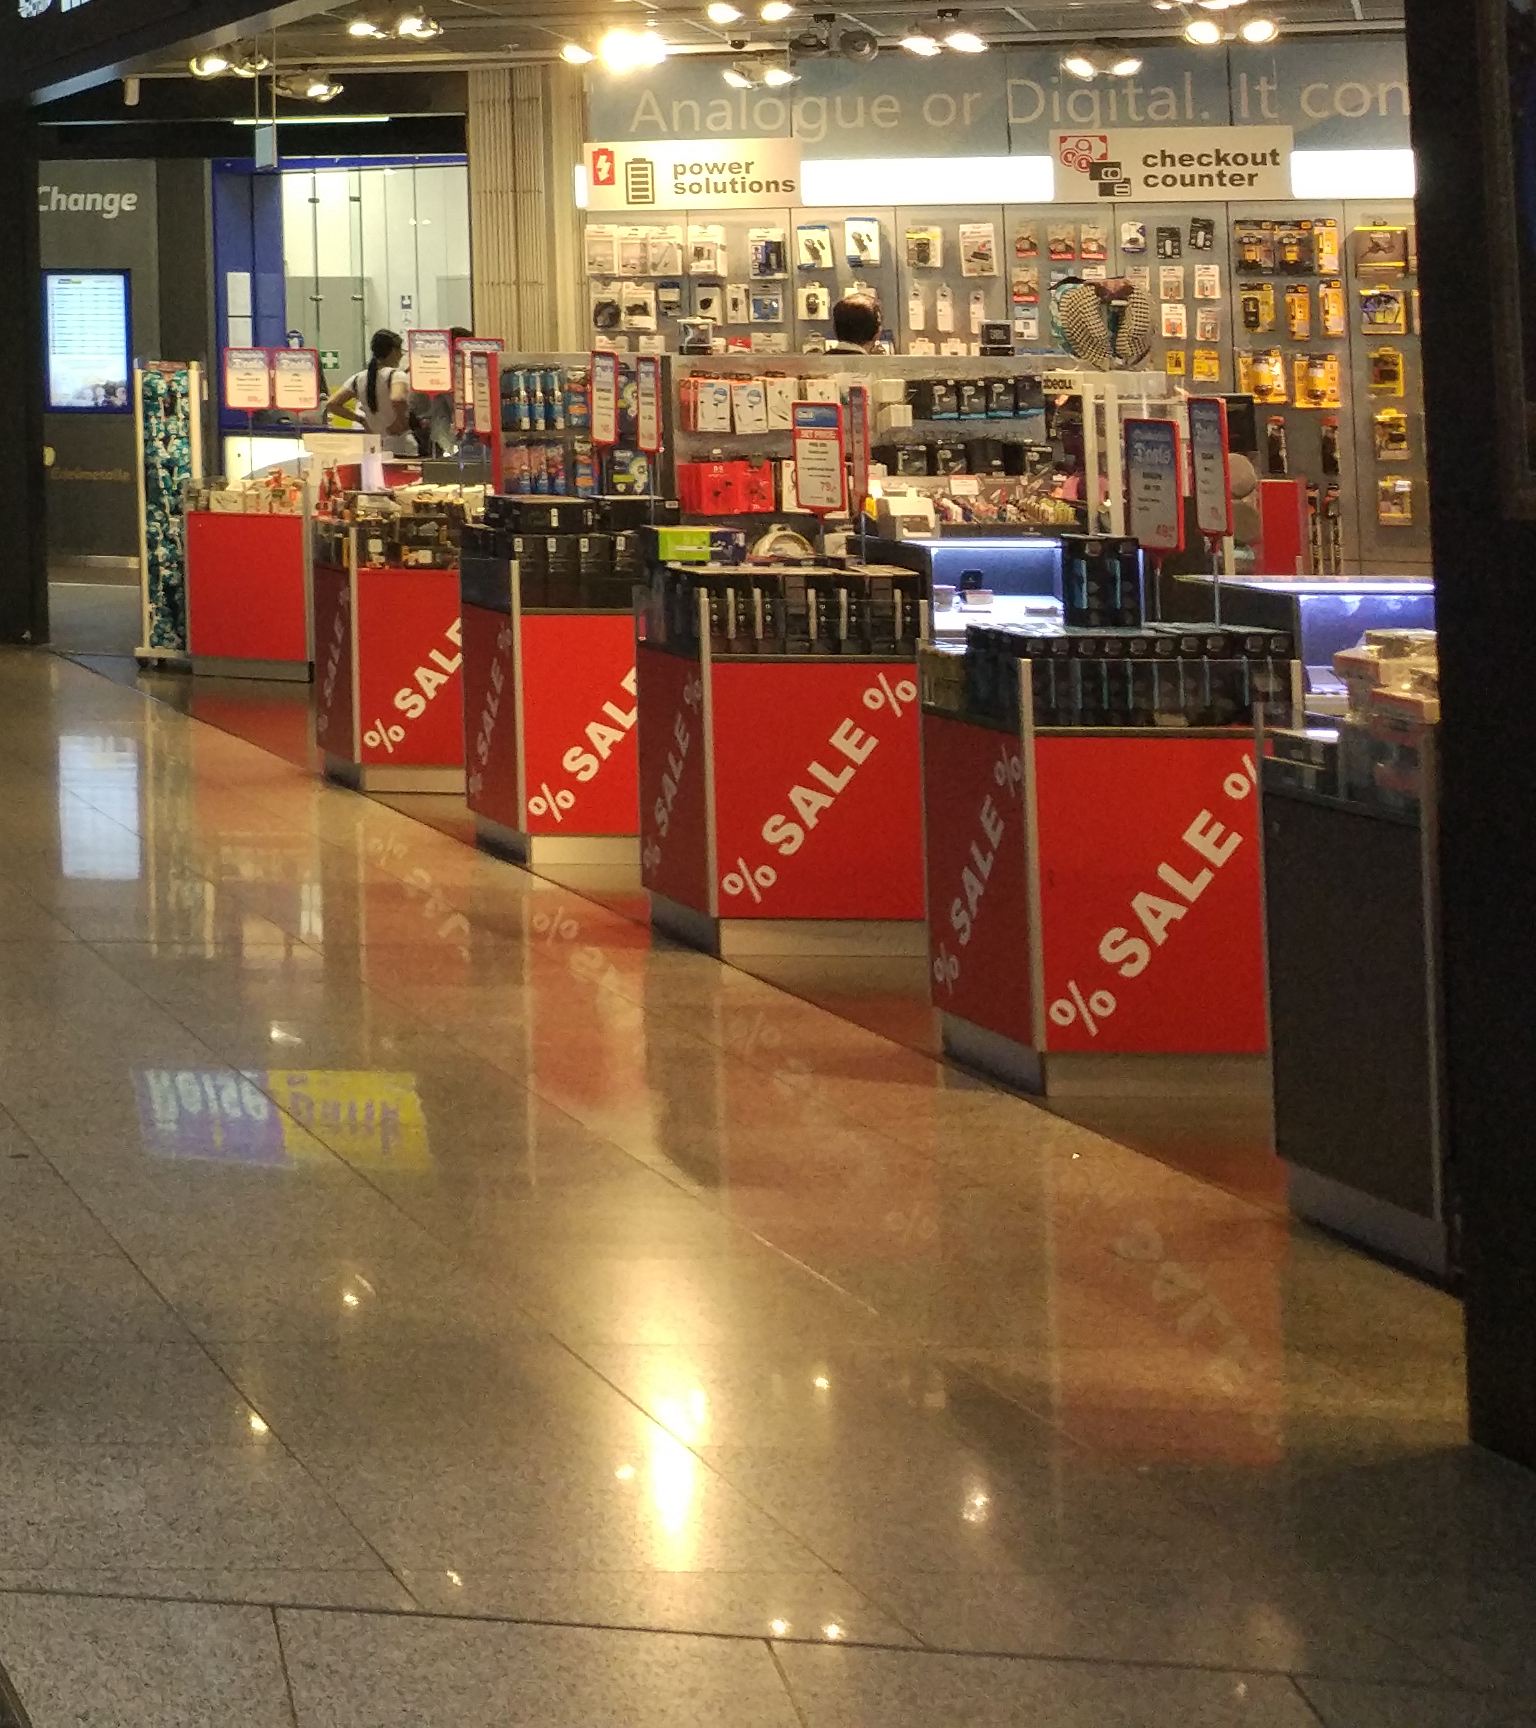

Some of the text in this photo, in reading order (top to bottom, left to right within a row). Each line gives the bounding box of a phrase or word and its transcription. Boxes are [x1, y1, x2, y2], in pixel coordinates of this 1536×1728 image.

[629, 86, 901, 143] Analogue
[922, 91, 982, 127] or
[1240, 72, 1278, 118] It
[672, 158, 755, 180] power
[673, 176, 796, 195] solutions
[1142, 148, 1280, 168] checkout
[1142, 170, 1259, 188] counter
[363, 718, 406, 753] %
[476, 657, 505, 766] SALE
[528, 781, 576, 824] %
[654, 711, 691, 838] SALE
[721, 672, 918, 904] % SALE %
[950, 793, 1006, 947] SALE
[1048, 979, 1117, 1037] %
[1098, 808, 1244, 978] SALE
